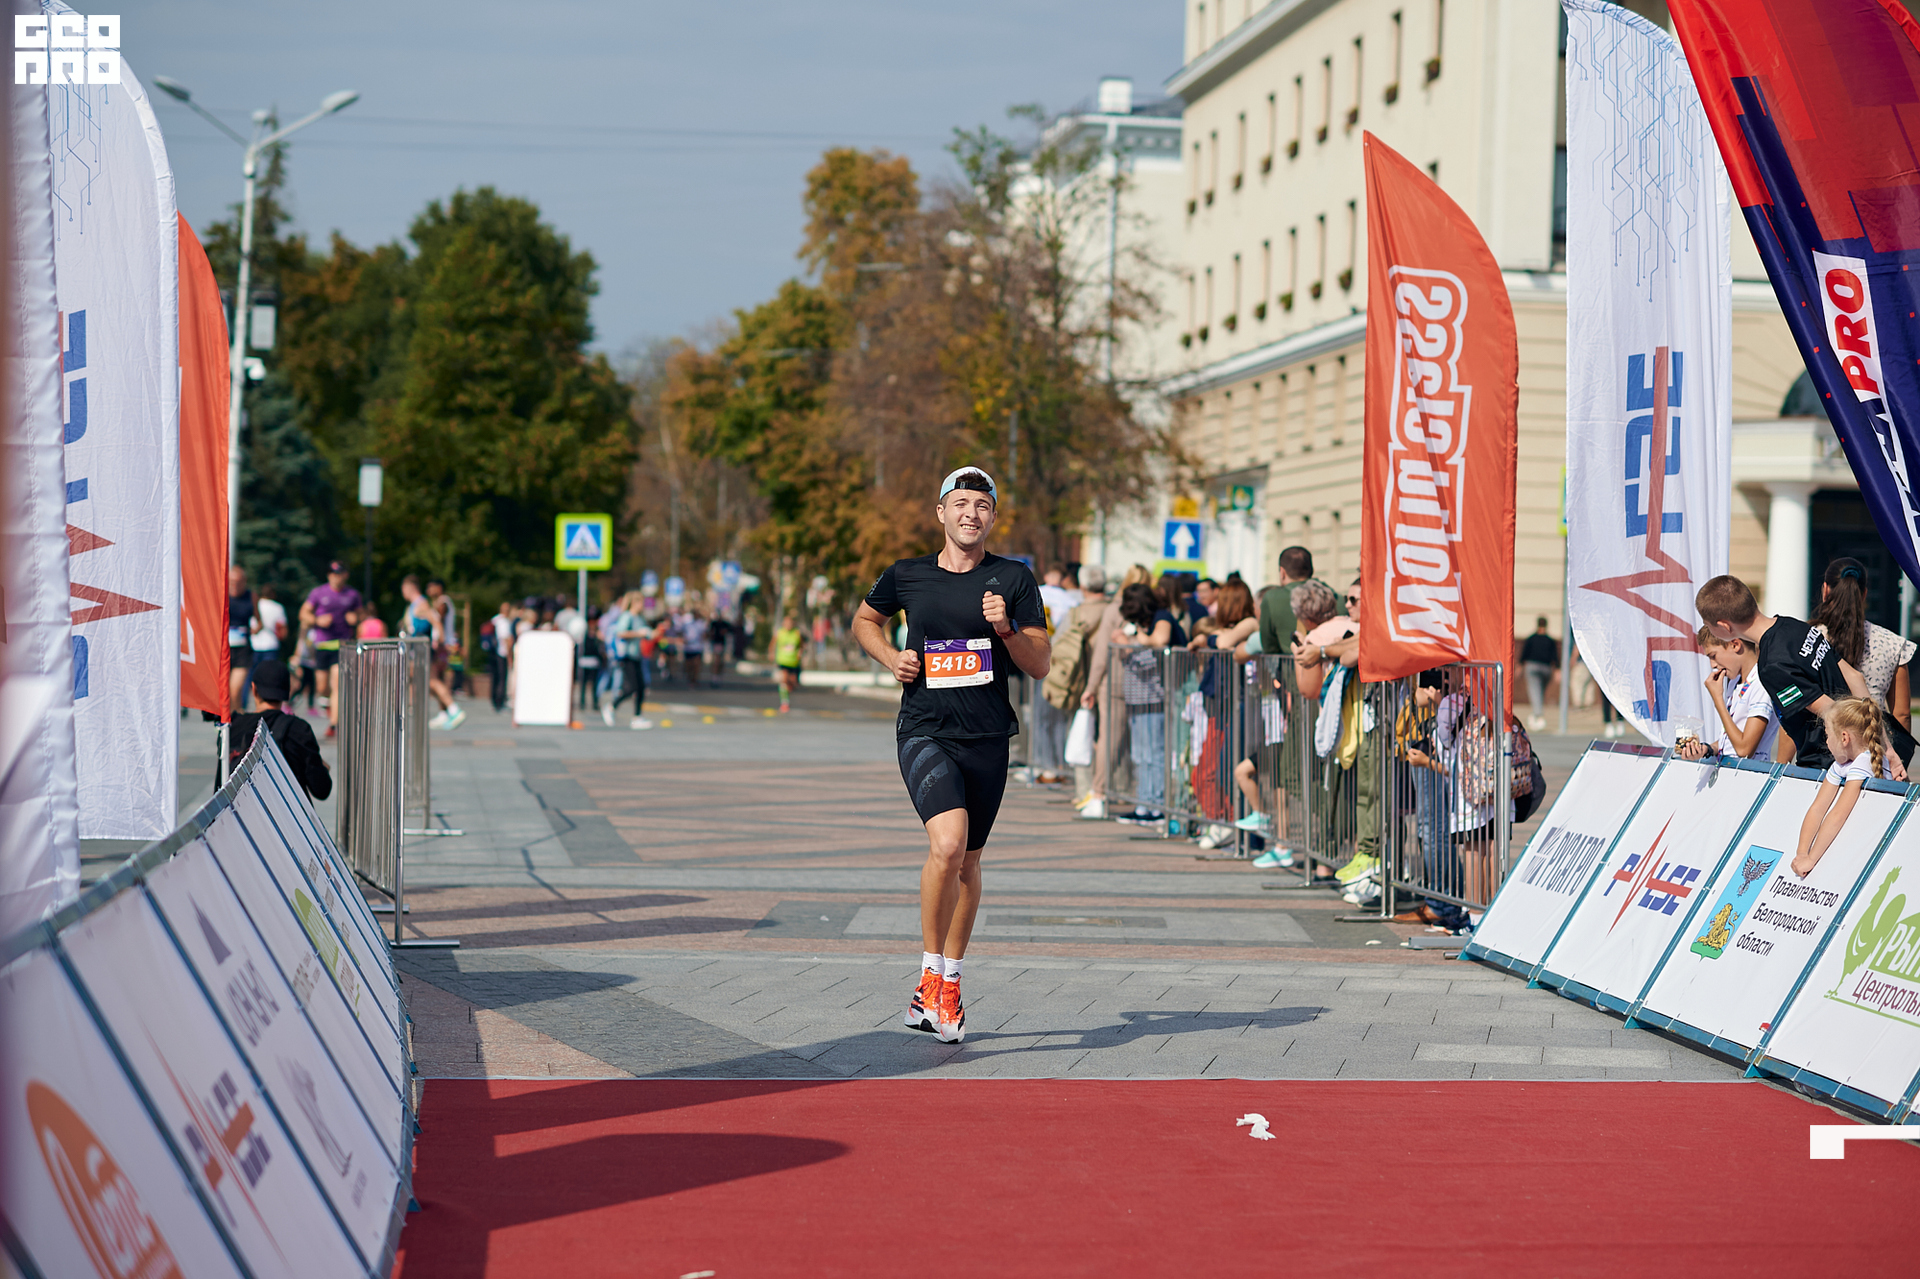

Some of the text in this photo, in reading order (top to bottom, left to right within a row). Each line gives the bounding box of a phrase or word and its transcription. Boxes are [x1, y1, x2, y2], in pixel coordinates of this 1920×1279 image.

[1825, 268, 1881, 396] PRO
[930, 654, 977, 672] 5418
[1769, 875, 1839, 908] Правительство
[1752, 902, 1821, 936] Белгородской
[1736, 931, 1775, 957] области
